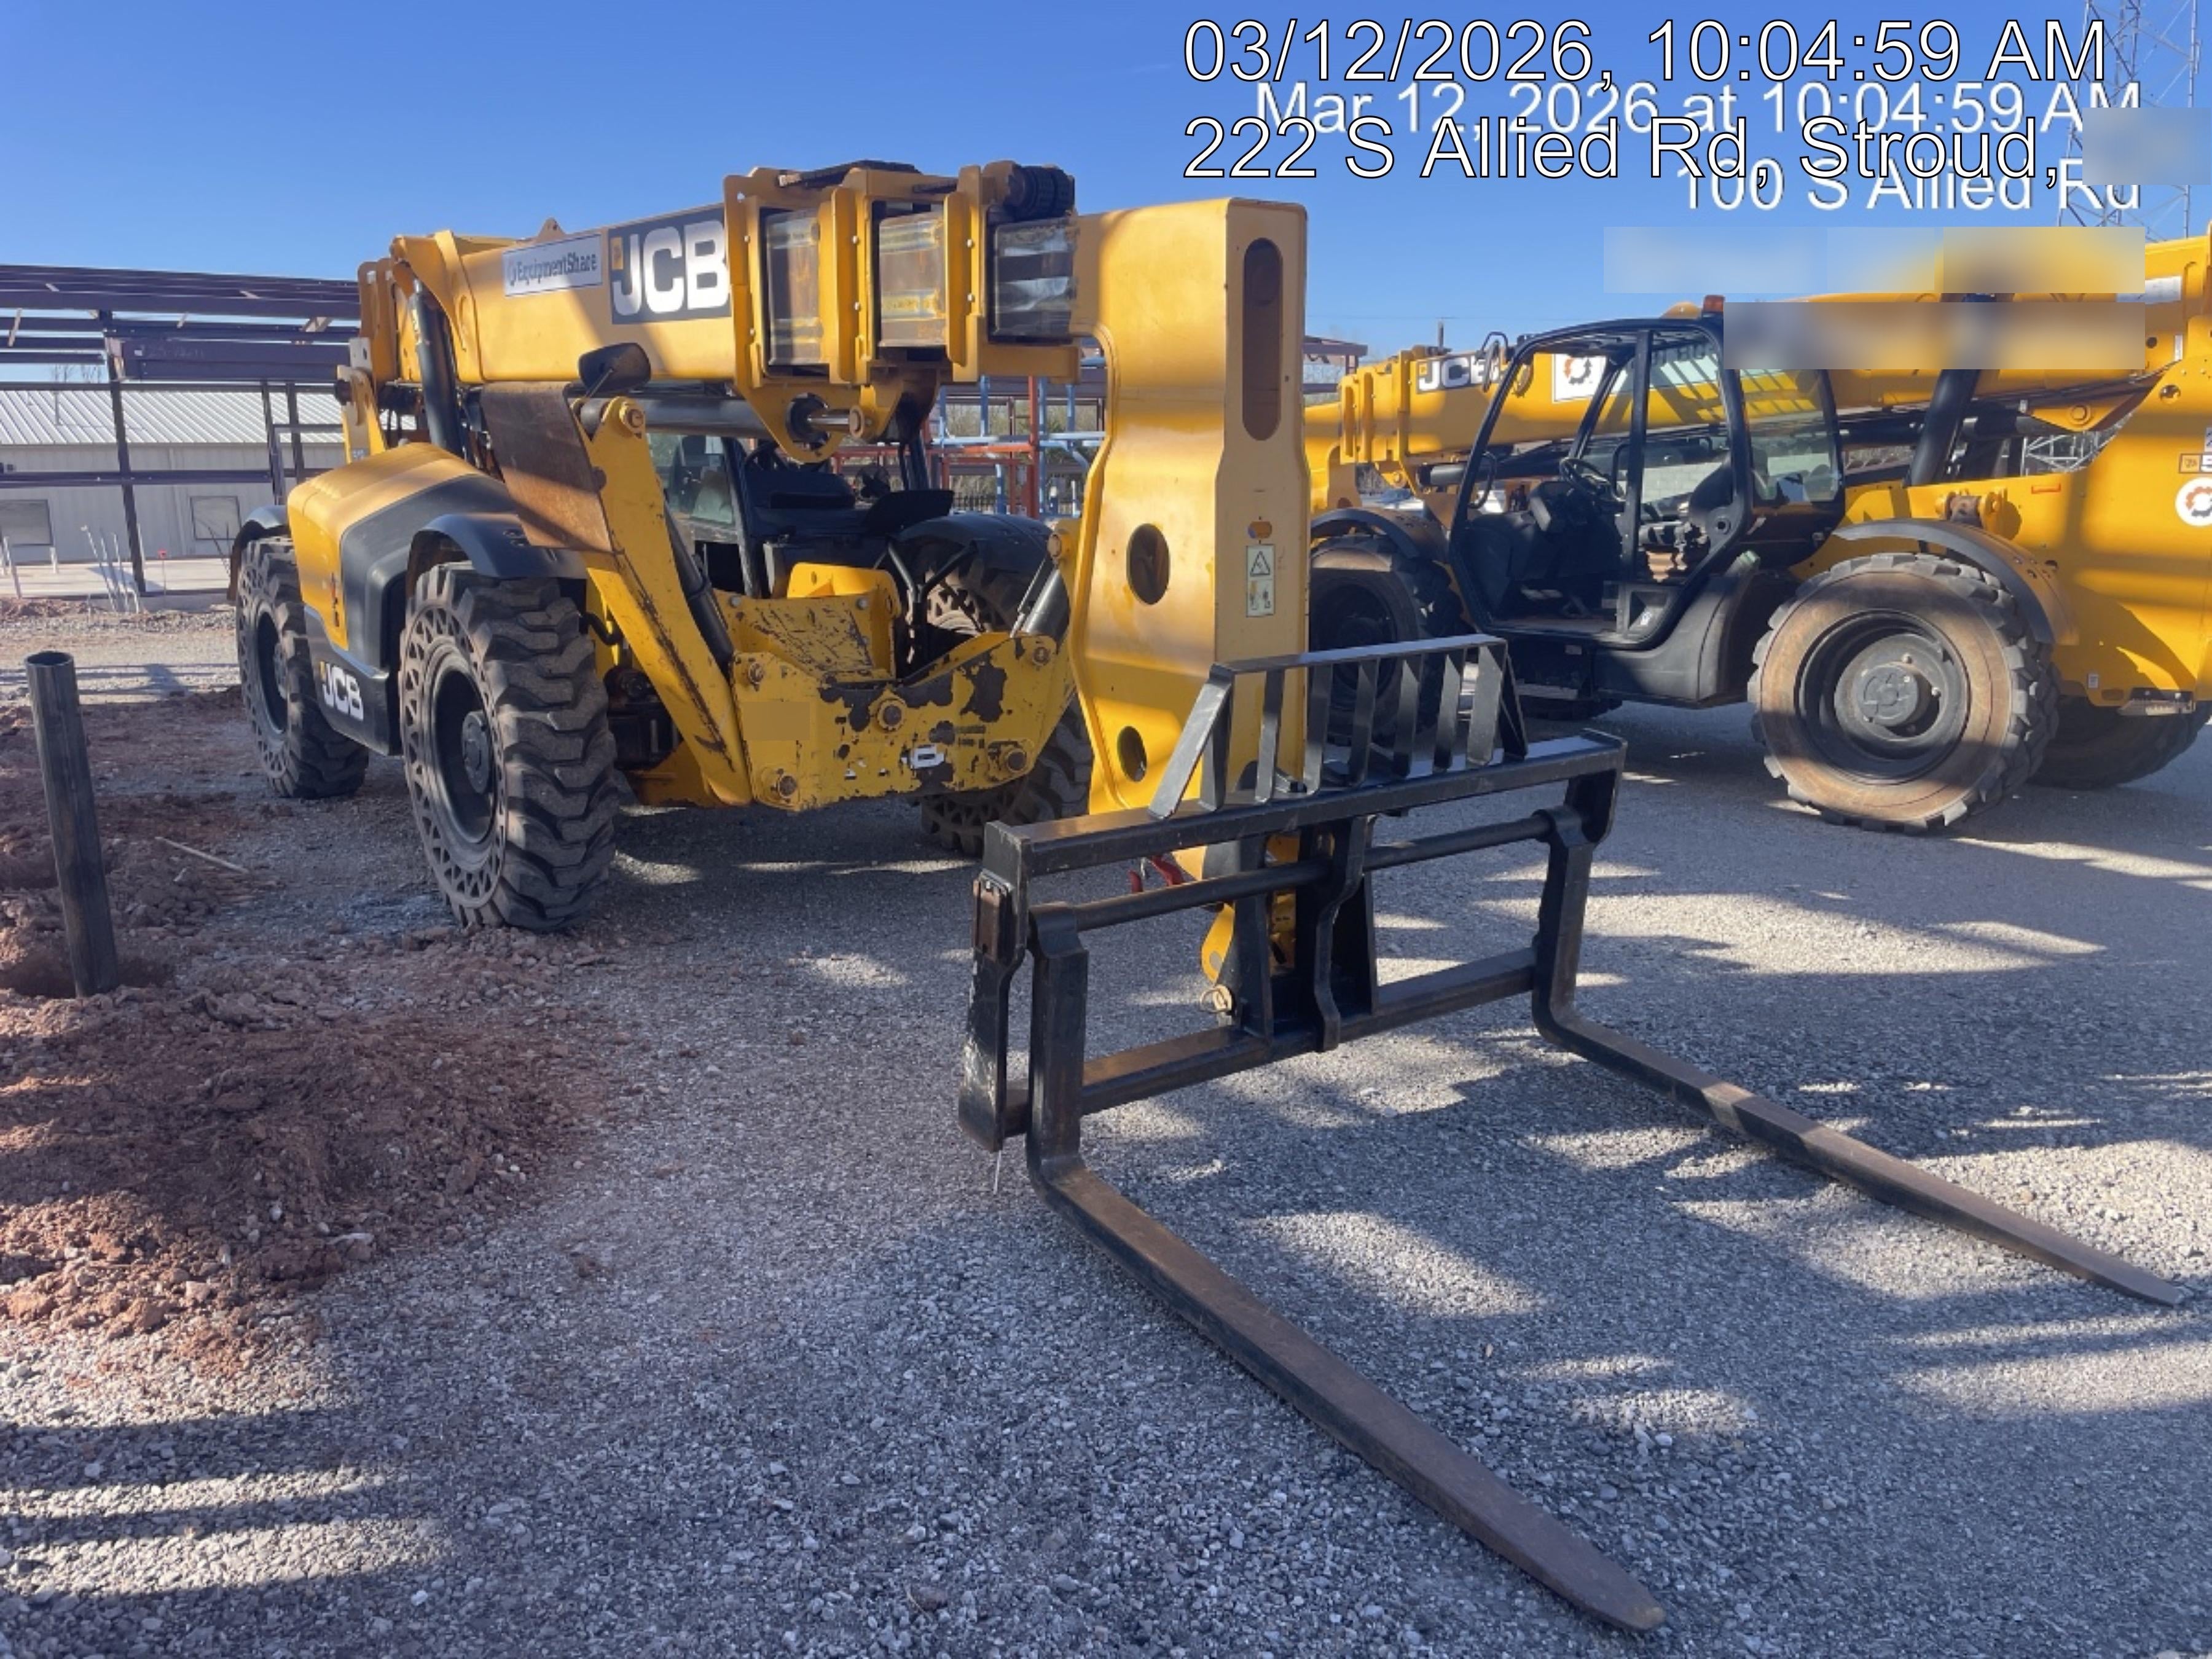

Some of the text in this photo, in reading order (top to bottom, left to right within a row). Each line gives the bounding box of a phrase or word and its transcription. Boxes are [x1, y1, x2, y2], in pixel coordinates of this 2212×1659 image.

[517, 251, 597, 286] EquipmentShare
[611, 219, 731, 316] JCB
[320, 661, 364, 722] JCB
